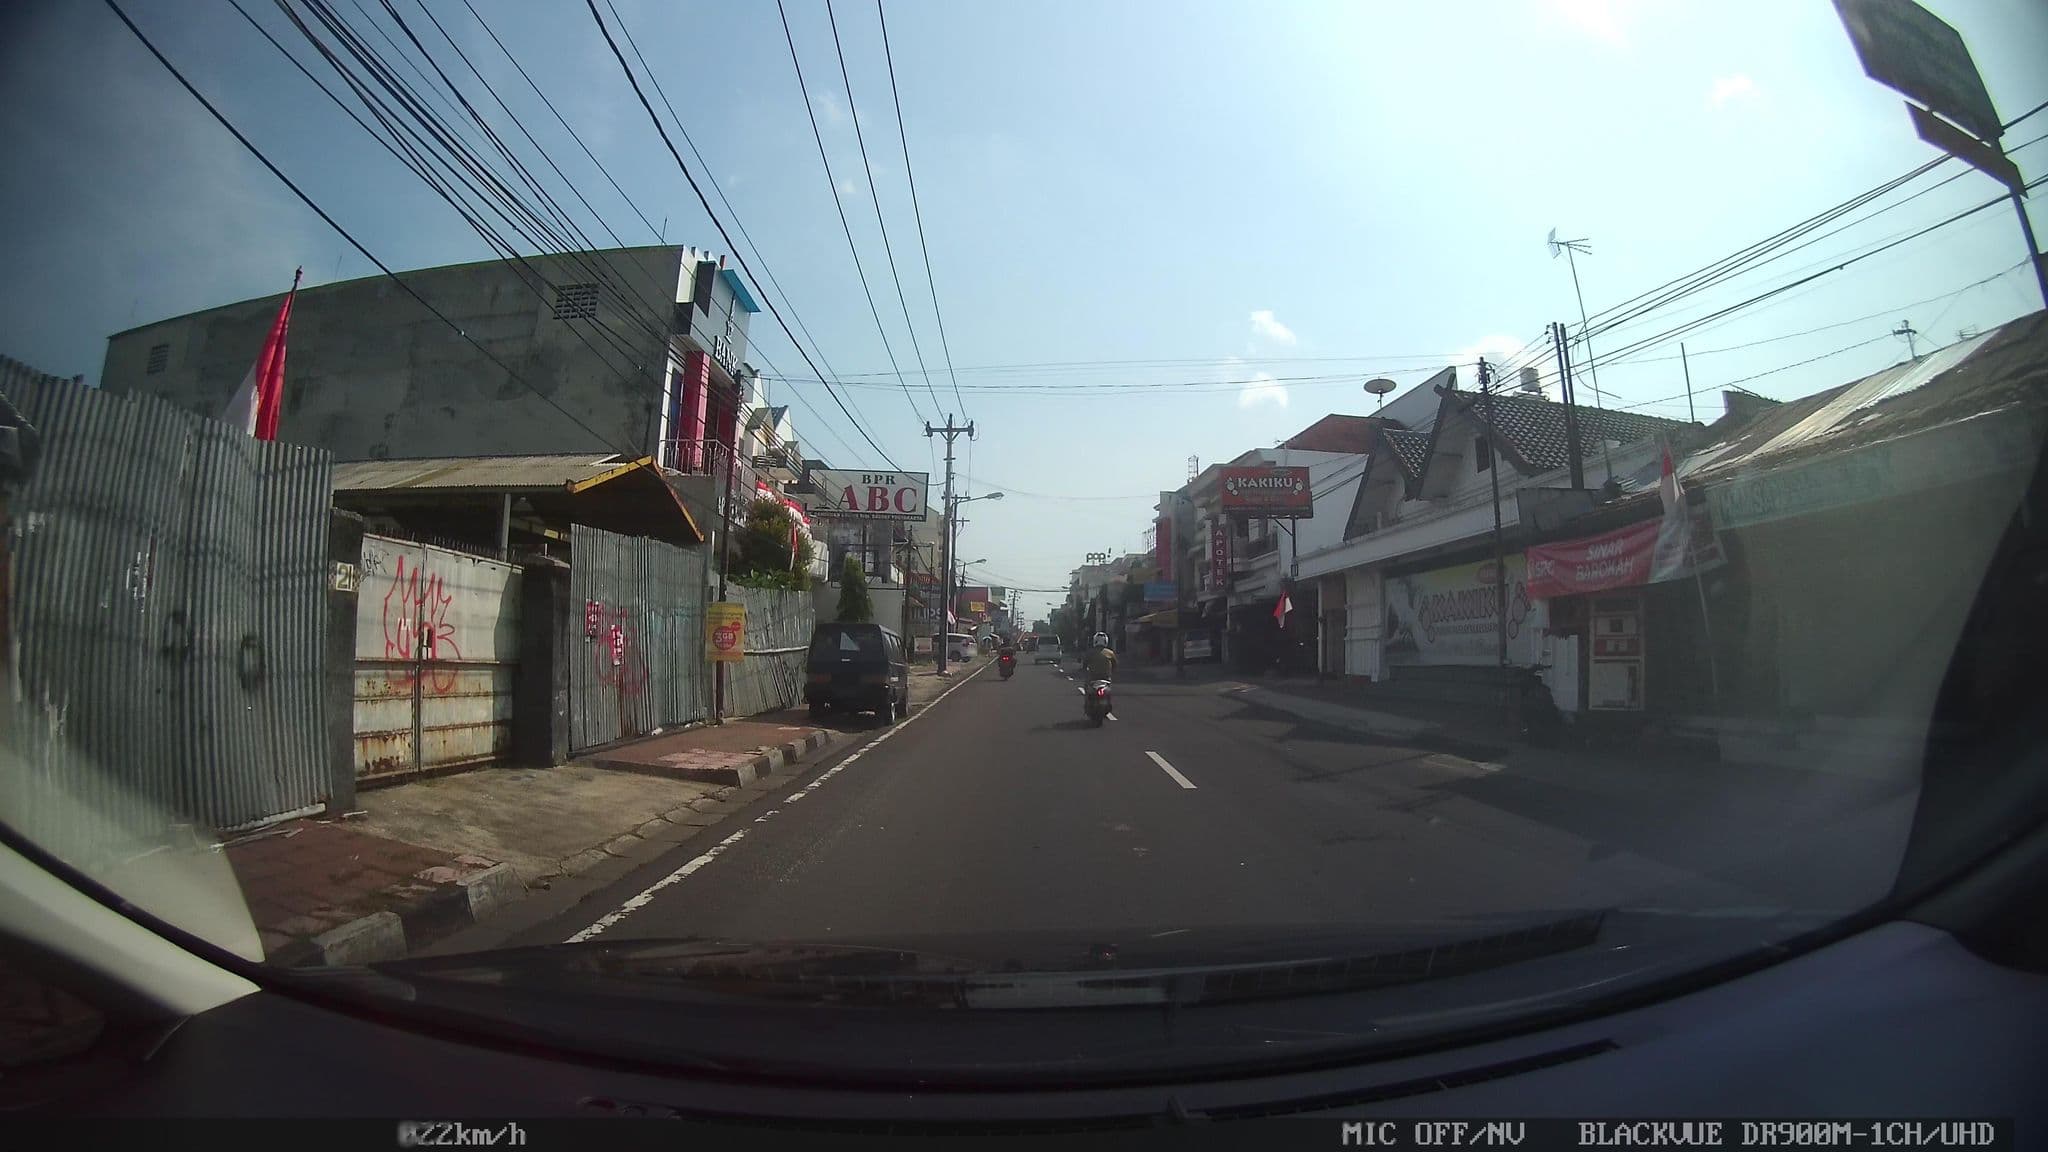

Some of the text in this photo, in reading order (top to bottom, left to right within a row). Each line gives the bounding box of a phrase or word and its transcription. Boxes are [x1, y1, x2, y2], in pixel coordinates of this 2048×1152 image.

[862, 474, 896, 485] BPR
[1238, 478, 1293, 489] KAKIKU
[838, 485, 917, 513] ABC
[1215, 530, 1224, 586] APOTEK
[1586, 540, 1624, 561] SINAR
